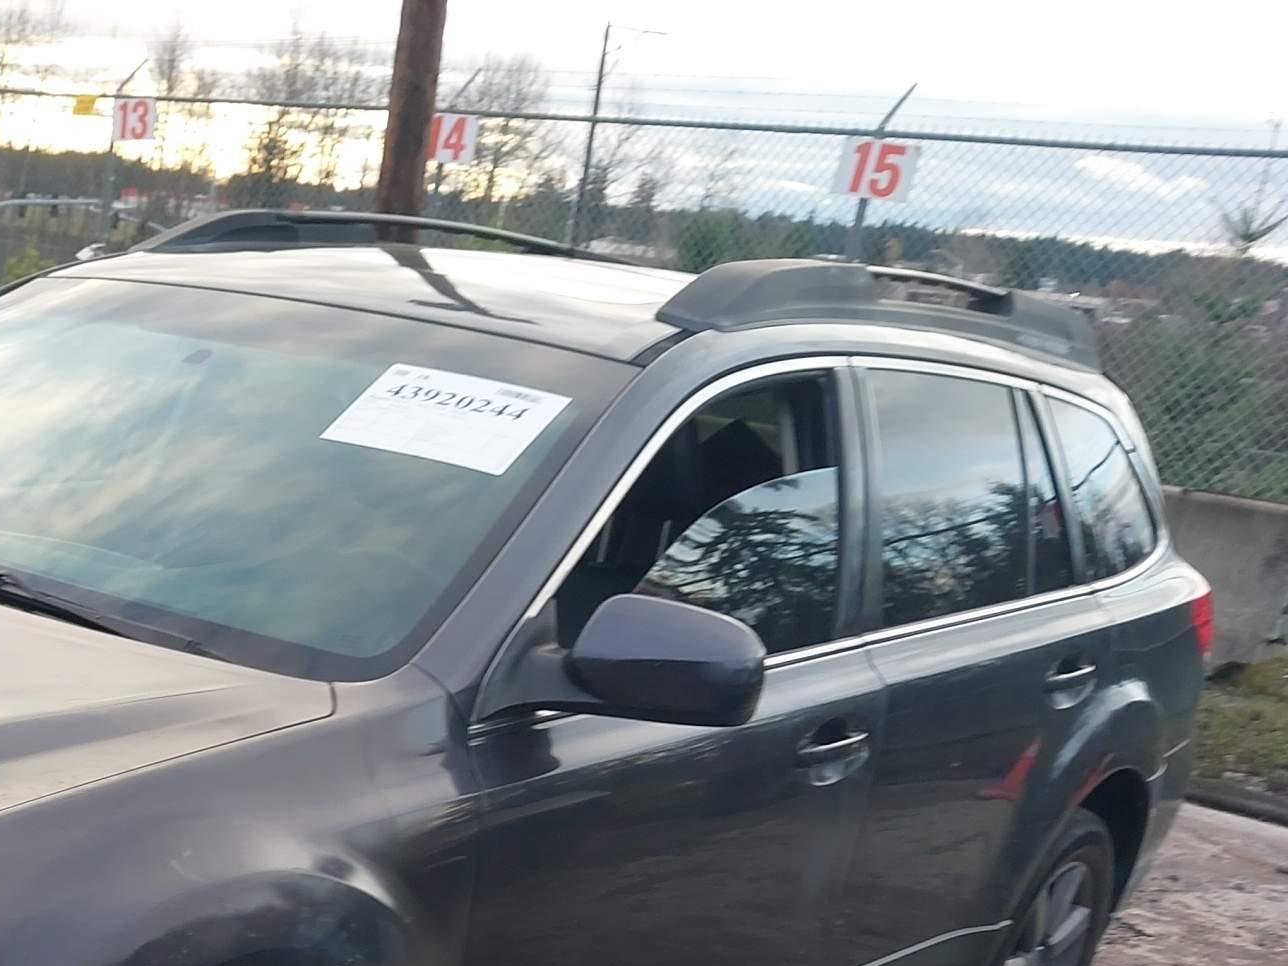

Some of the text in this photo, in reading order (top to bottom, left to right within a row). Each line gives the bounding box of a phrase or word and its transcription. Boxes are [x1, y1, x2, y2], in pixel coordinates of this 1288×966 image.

[118, 99, 149, 139] 13
[424, 115, 468, 160] 14
[848, 140, 907, 198] 15
[385, 383, 531, 421] 43920244
